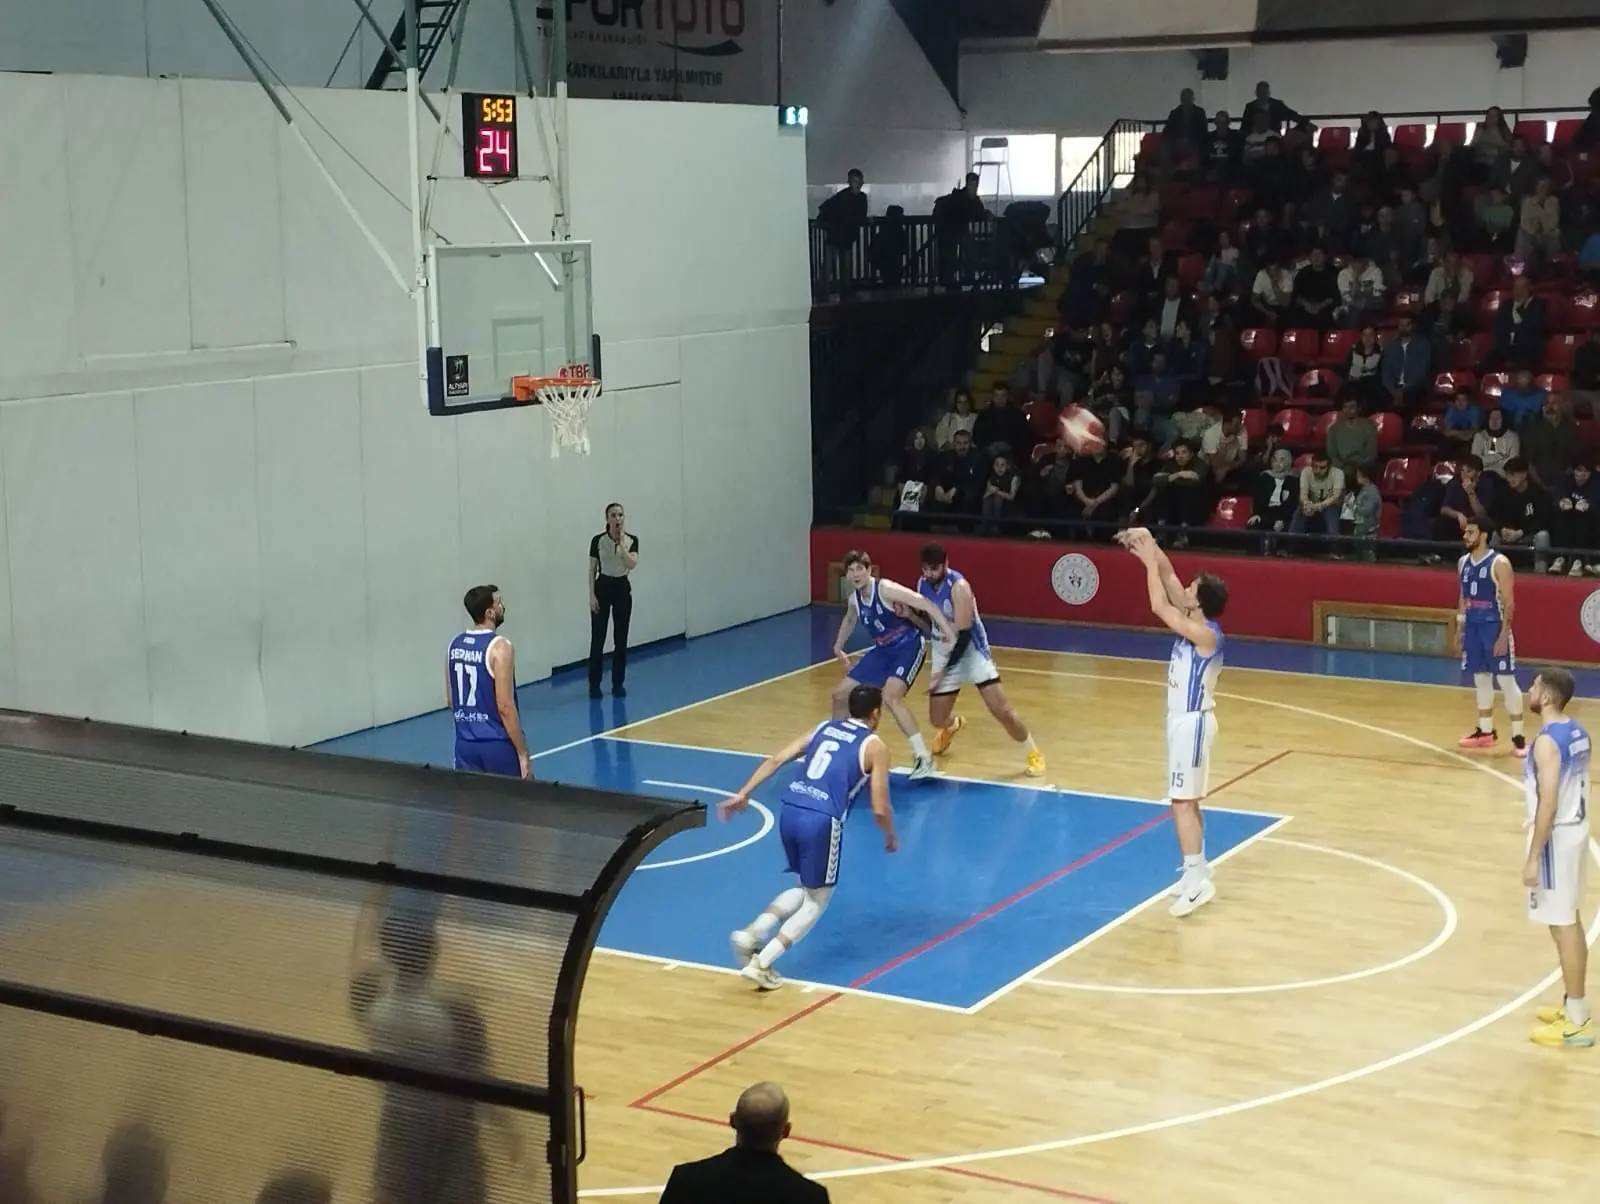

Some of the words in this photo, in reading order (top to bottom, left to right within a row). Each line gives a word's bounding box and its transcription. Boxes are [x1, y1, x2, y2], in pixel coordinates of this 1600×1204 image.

[482, 97, 513, 123] 5:53
[479, 129, 511, 172] 24
[454, 661, 478, 707] 17
[806, 739, 840, 780] 6
[1171, 771, 1184, 788] 15
[1530, 892, 1538, 910] 5
